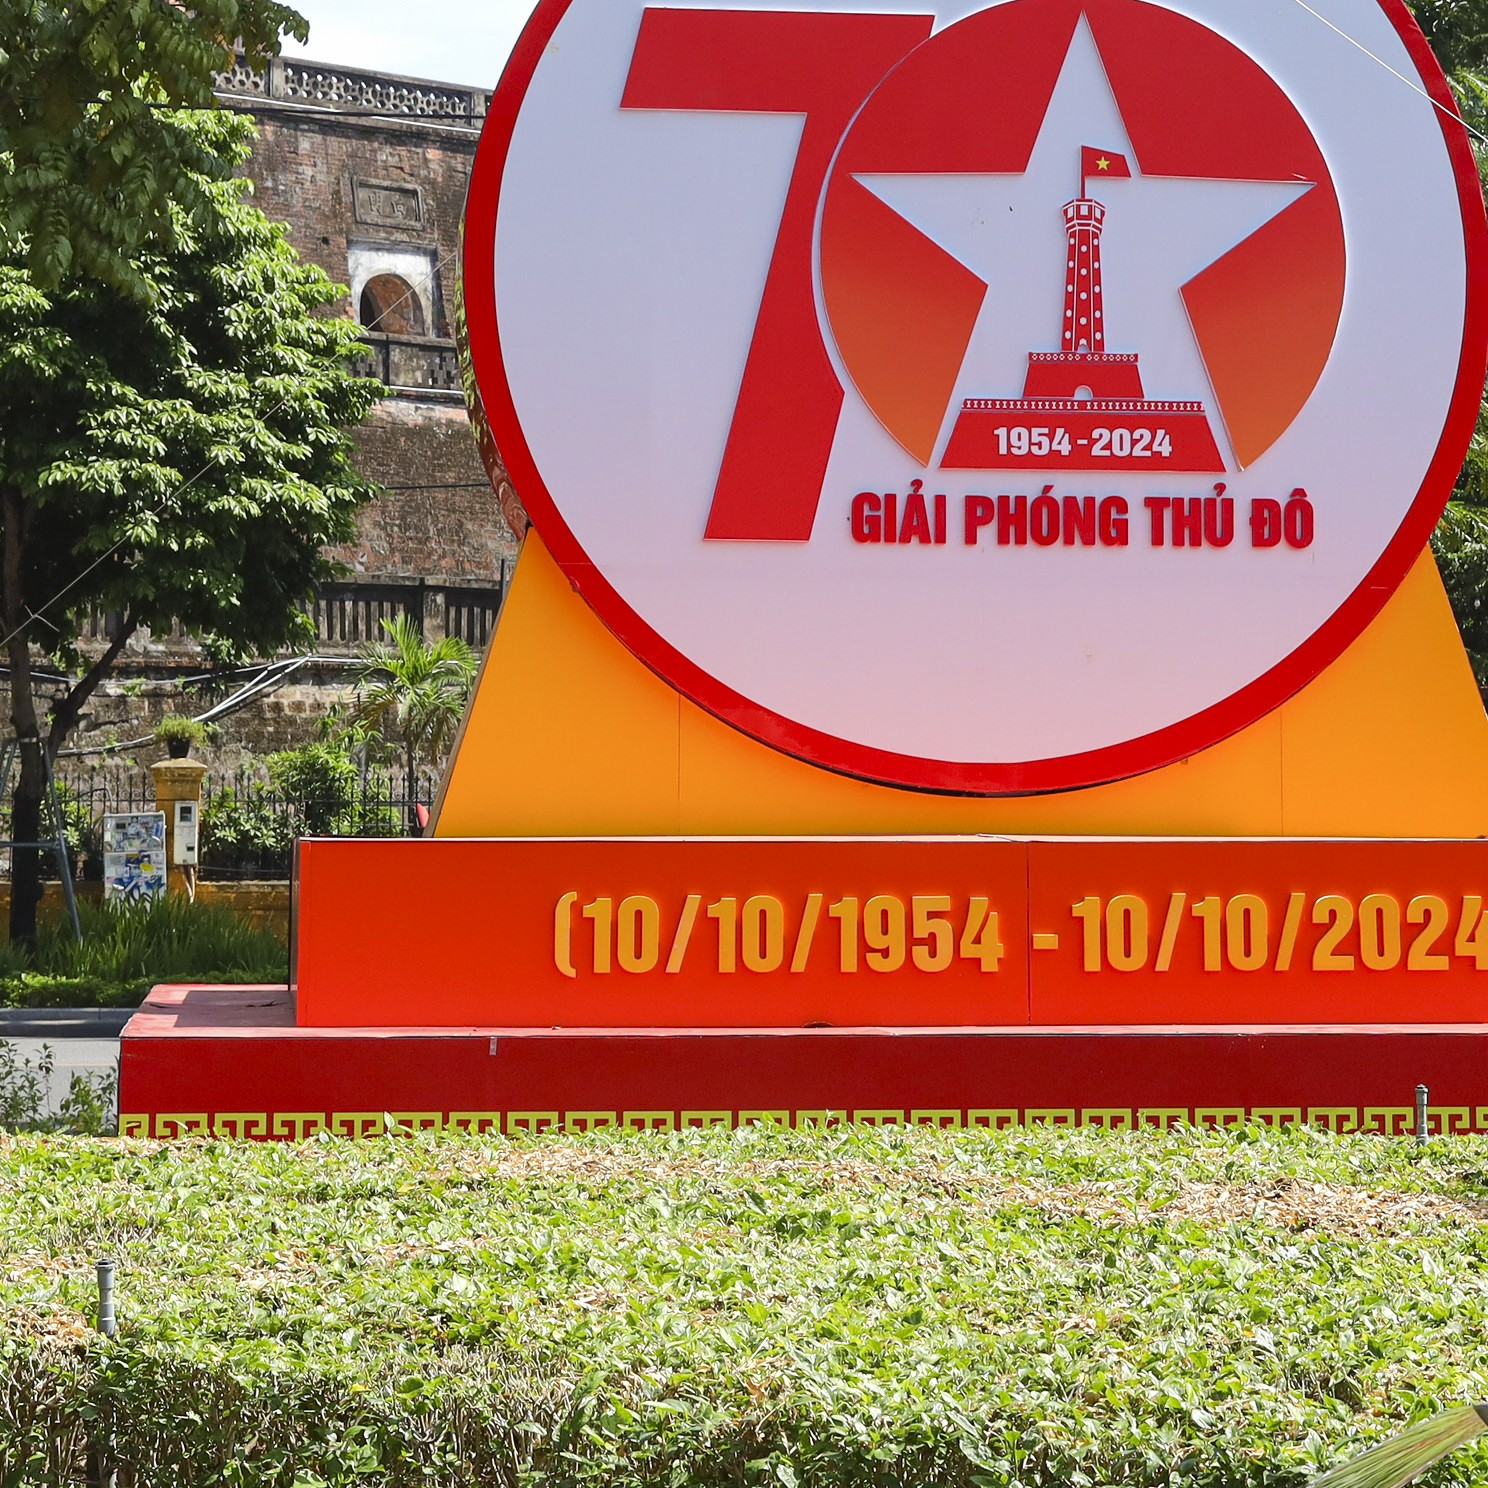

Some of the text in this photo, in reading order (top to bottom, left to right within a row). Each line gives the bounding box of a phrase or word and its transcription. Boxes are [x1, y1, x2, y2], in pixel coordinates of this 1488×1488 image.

[851, 479, 1315, 549] GIẢI PHÓNG THỦ ĐÔ
[553, 891, 1004, 978] (10/10/1954
